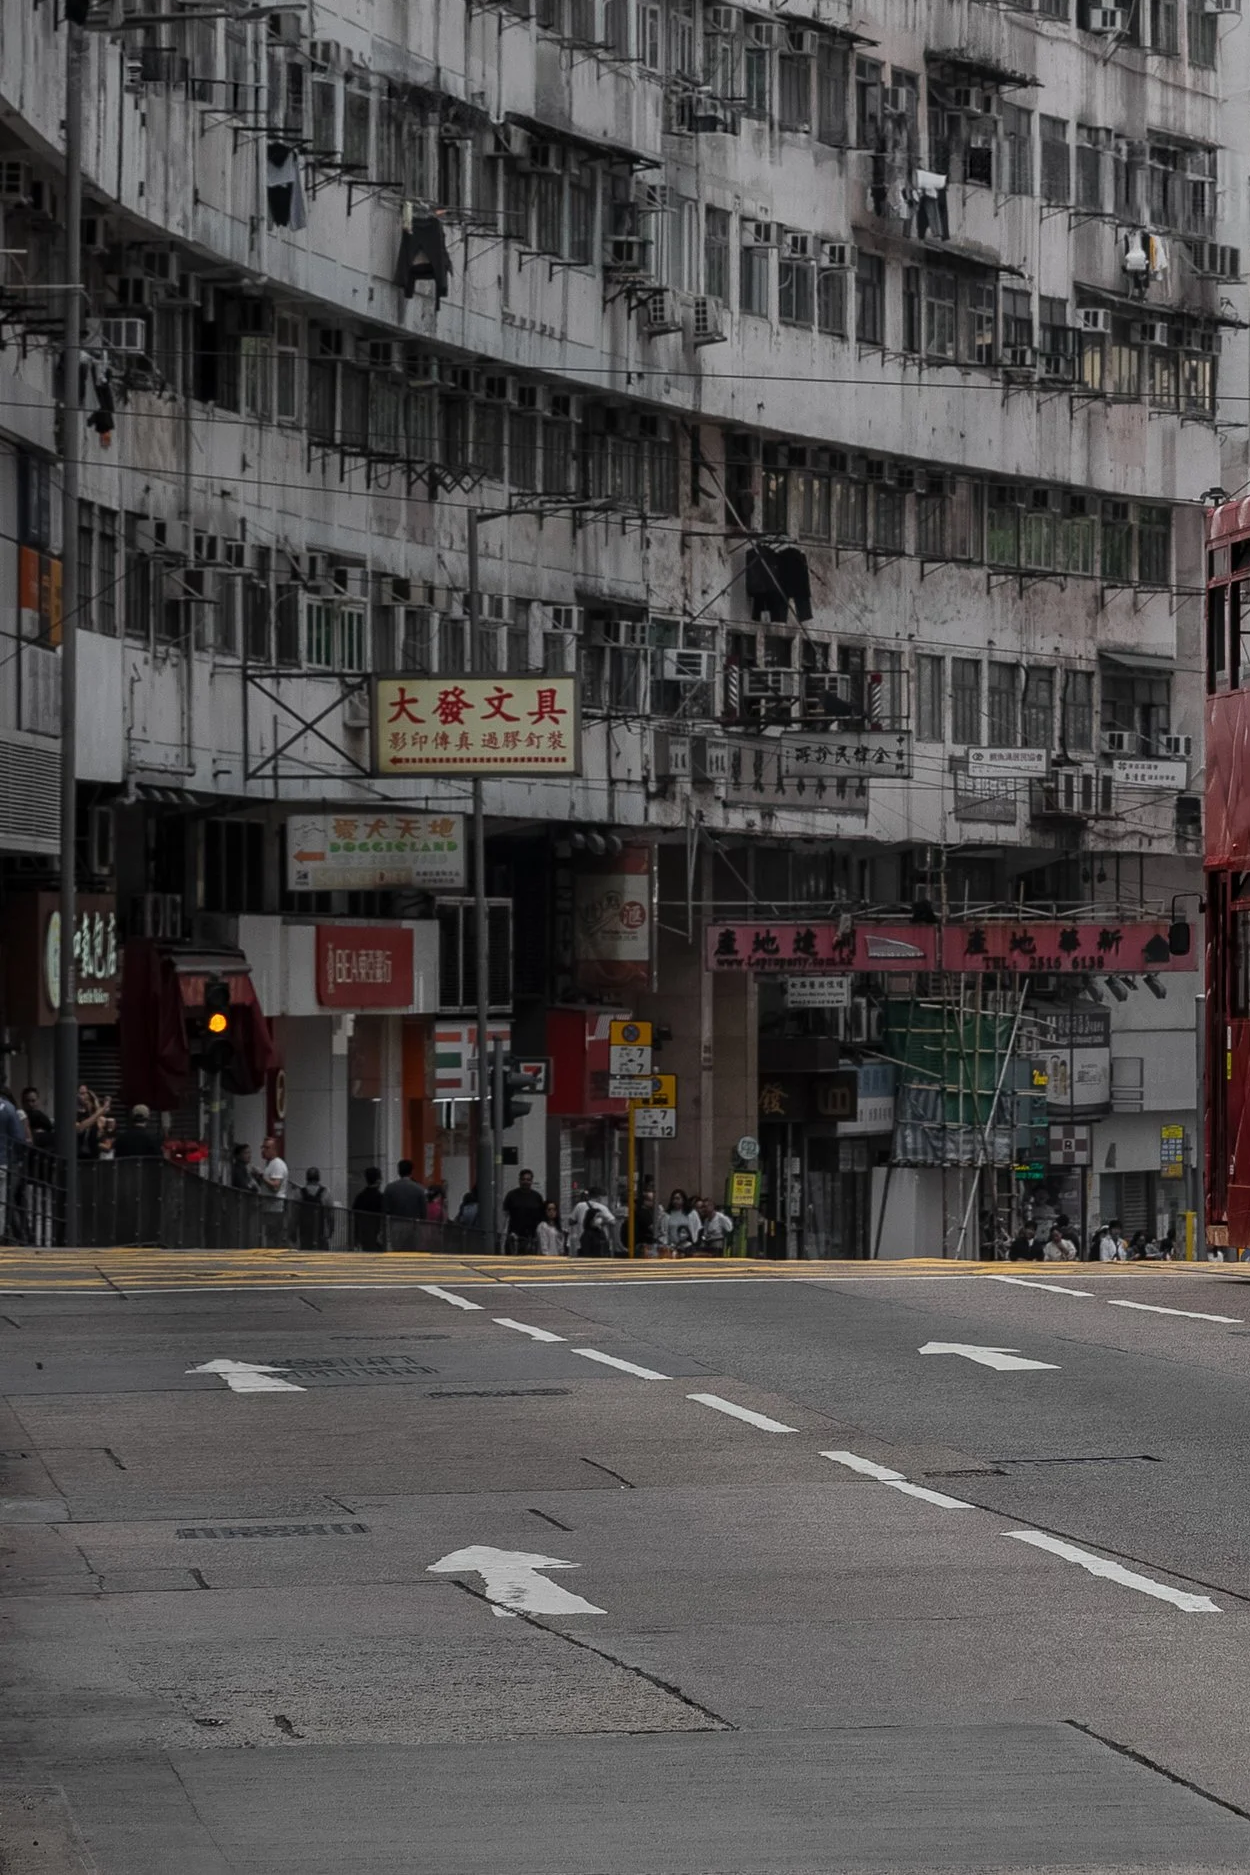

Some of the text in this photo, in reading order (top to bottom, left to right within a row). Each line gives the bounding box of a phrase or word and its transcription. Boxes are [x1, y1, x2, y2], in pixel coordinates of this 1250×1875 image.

[387, 686, 567, 725] 大發文具
[388, 730, 567, 751] 影印傳真 過膠釘裝
[636, 1048, 645, 1058] 7
[636, 1063, 644, 1073] 7
[660, 1110, 668, 1121] 7
[661, 1125, 674, 1136] 12
